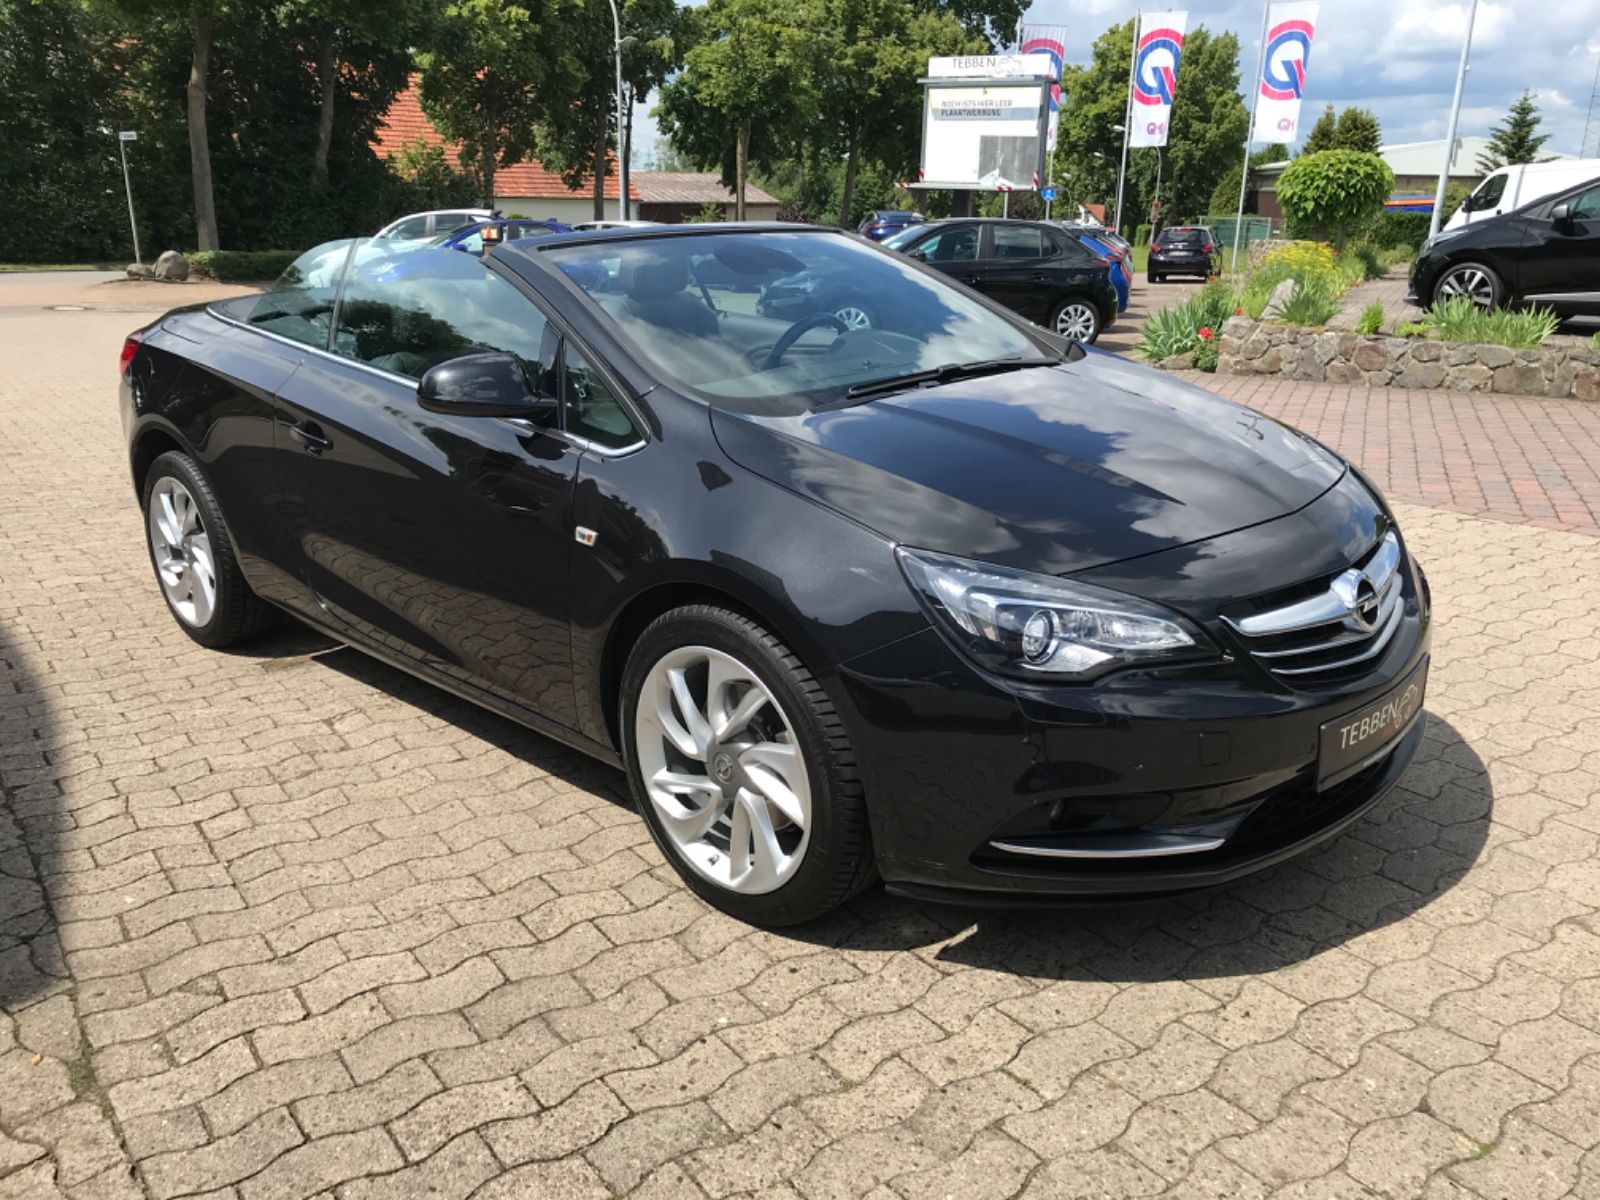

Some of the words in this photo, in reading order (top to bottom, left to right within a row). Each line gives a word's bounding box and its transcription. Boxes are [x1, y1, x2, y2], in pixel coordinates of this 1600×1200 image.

[952, 57, 996, 69] TEBBEN
[941, 108, 1001, 116] PLAKATWERBUNG
[1147, 122, 1165, 135] Q1
[1277, 118, 1294, 131] Q1
[1340, 697, 1399, 749] TEBBEN
